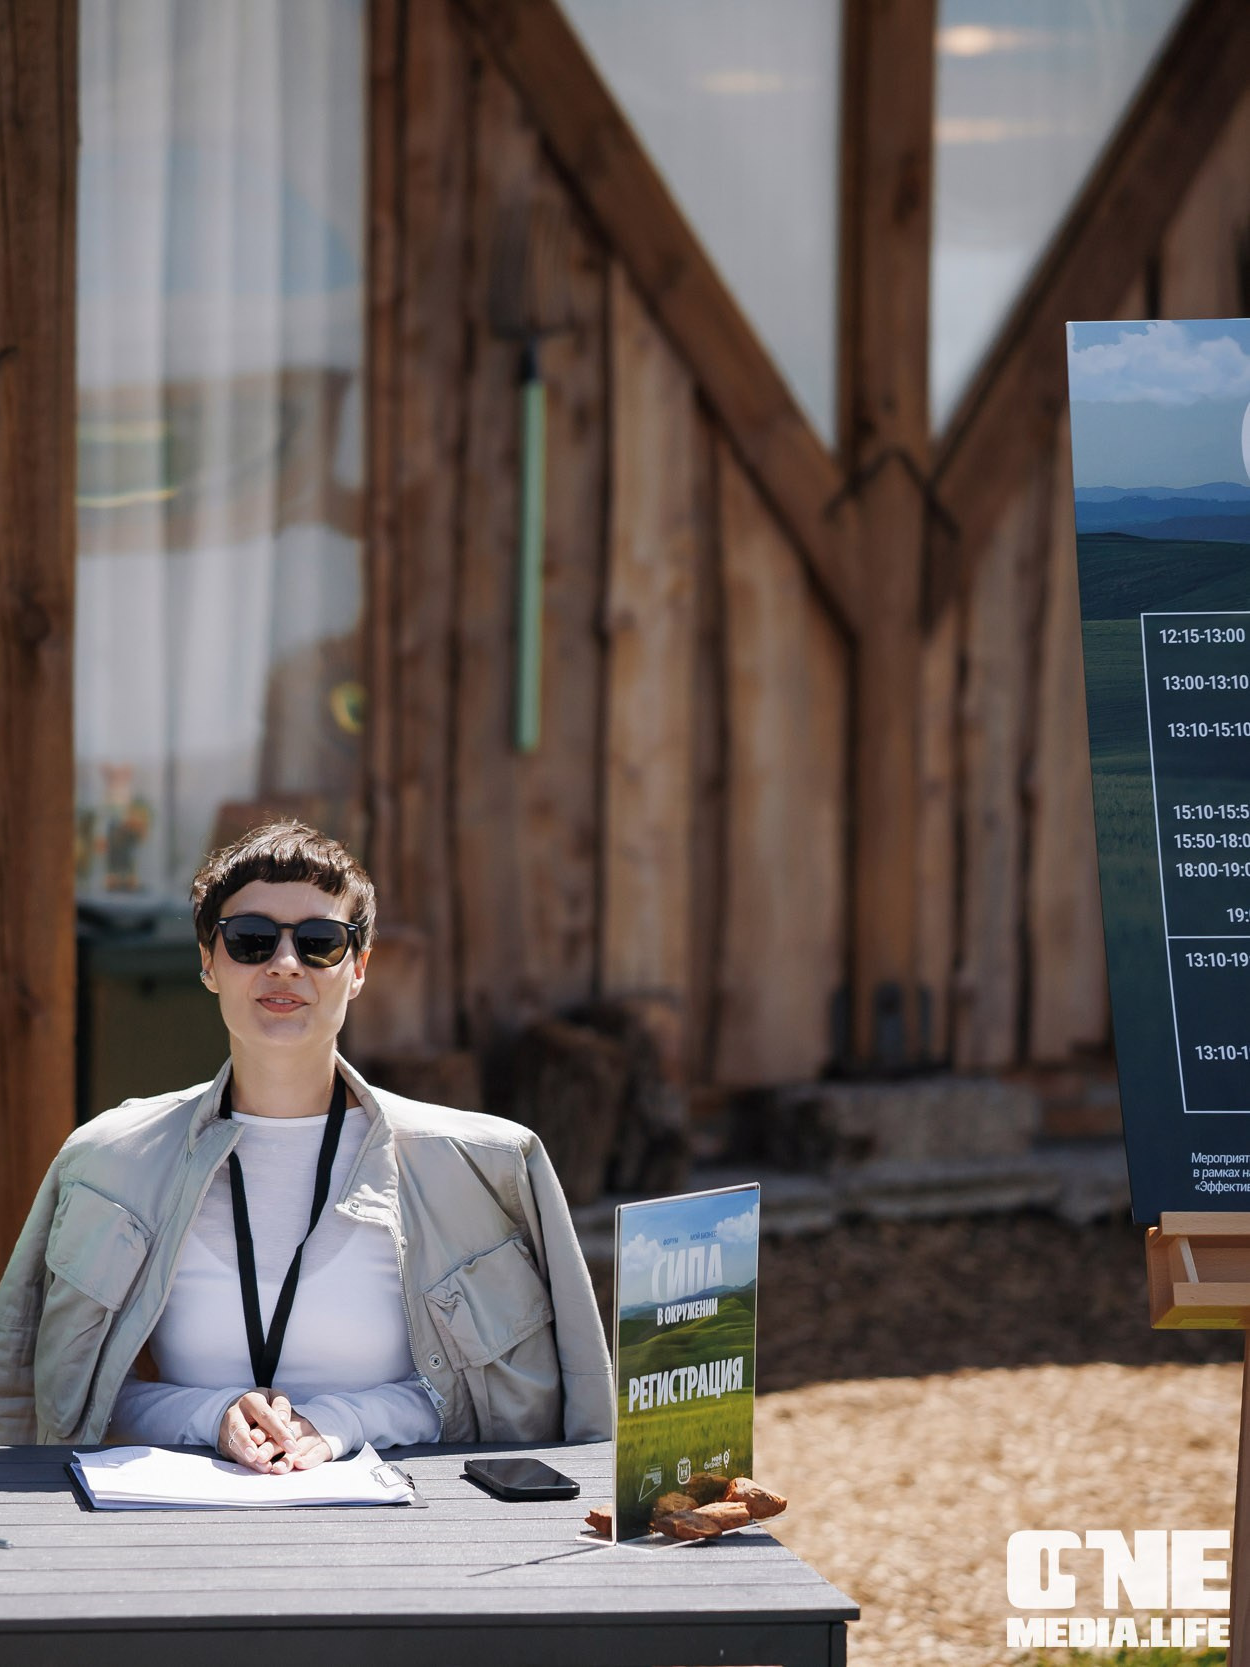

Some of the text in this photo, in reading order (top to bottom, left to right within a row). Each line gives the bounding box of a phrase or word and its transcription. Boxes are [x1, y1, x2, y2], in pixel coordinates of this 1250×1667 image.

[1159, 628, 1246, 644] 12:15-13:00
[1162, 674, 1249, 690] 13:00-13:10
[1167, 722, 1250, 737] 13:10-15:10
[1226, 907, 1250, 922] 19:
[1195, 1045, 1250, 1060] 13:10-1
[1193, 1169, 1250, 1180] в рамках н
[657, 1297, 718, 1326] В ОКРУЖЕНИИ
[629, 1356, 744, 1413] РЕГИСТРАЦИЯ
